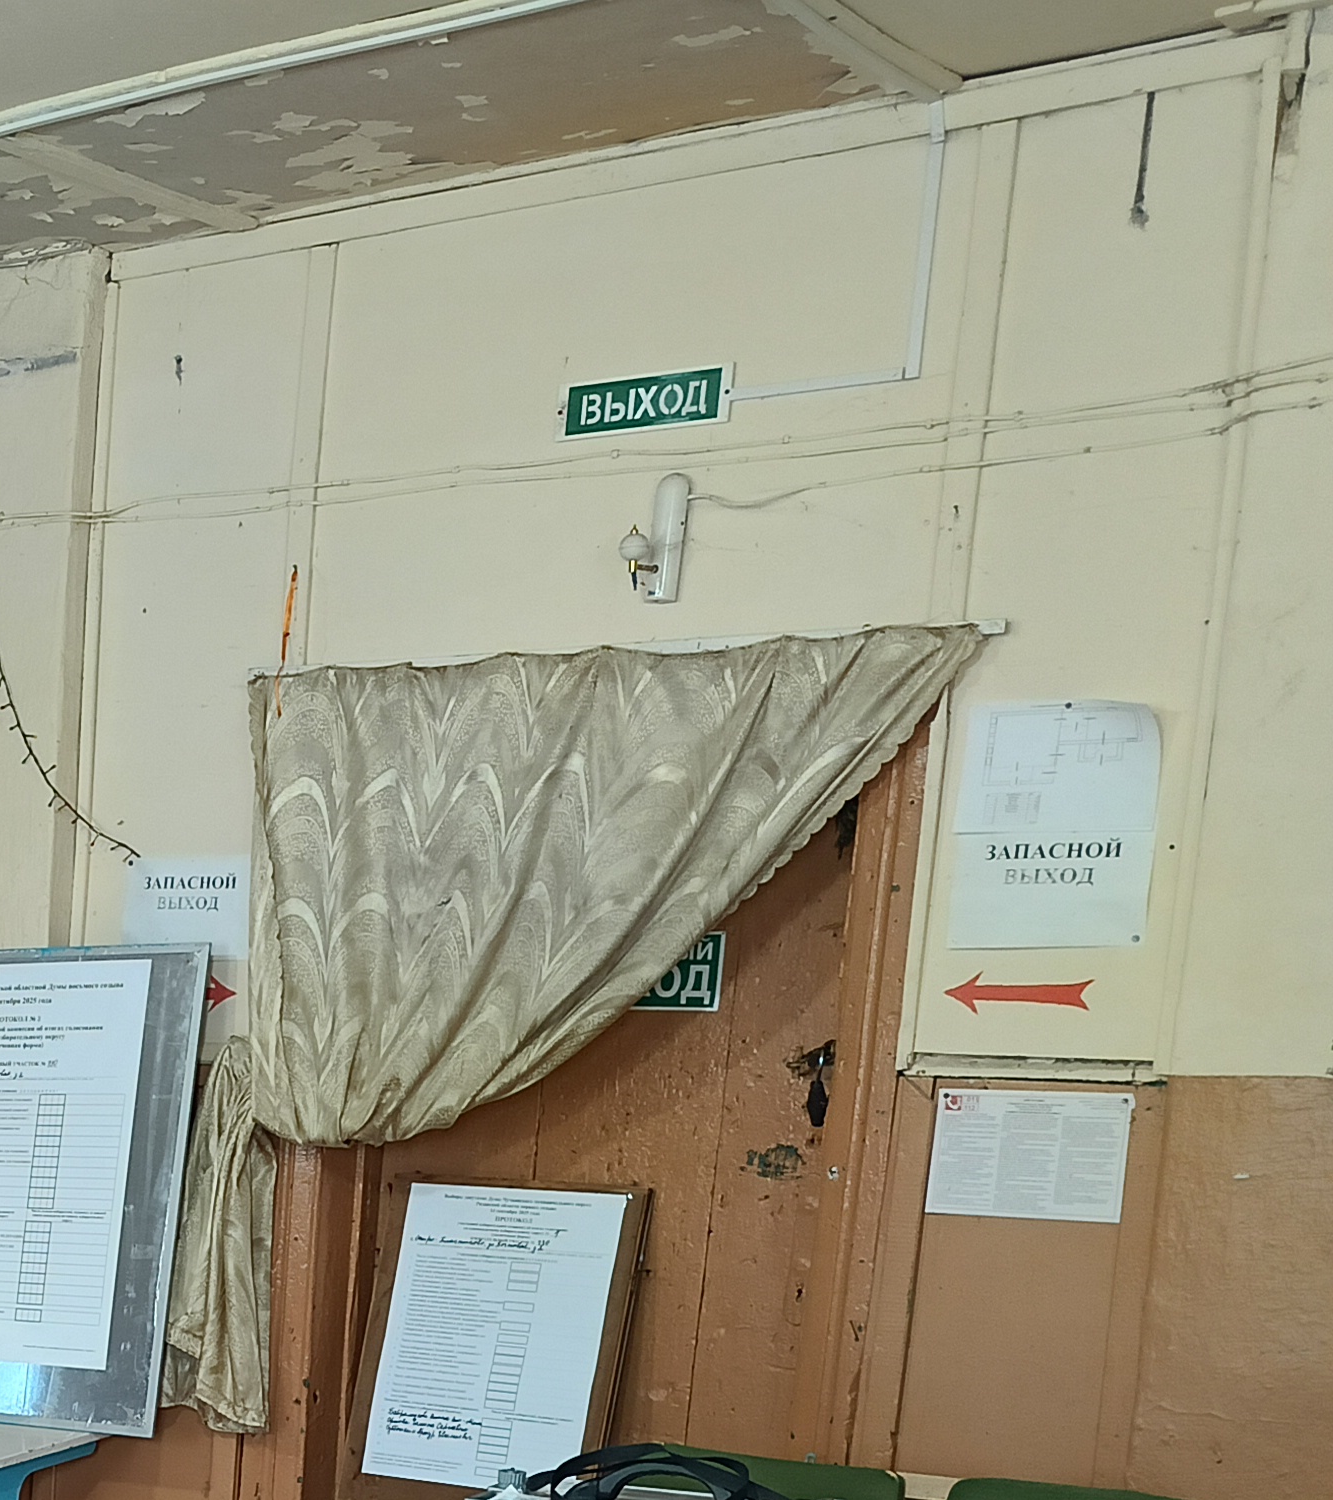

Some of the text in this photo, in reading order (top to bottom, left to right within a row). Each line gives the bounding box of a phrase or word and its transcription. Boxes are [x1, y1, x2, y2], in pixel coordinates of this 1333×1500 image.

[580, 380, 708, 426] ВЫХОД
[985, 838, 1122, 860] ЗАПАСНОЙ
[144, 872, 236, 890] ЗАПАСНОЙ
[1003, 868, 1095, 886] ВЫХОД
[157, 896, 219, 912] ВЫХОД
